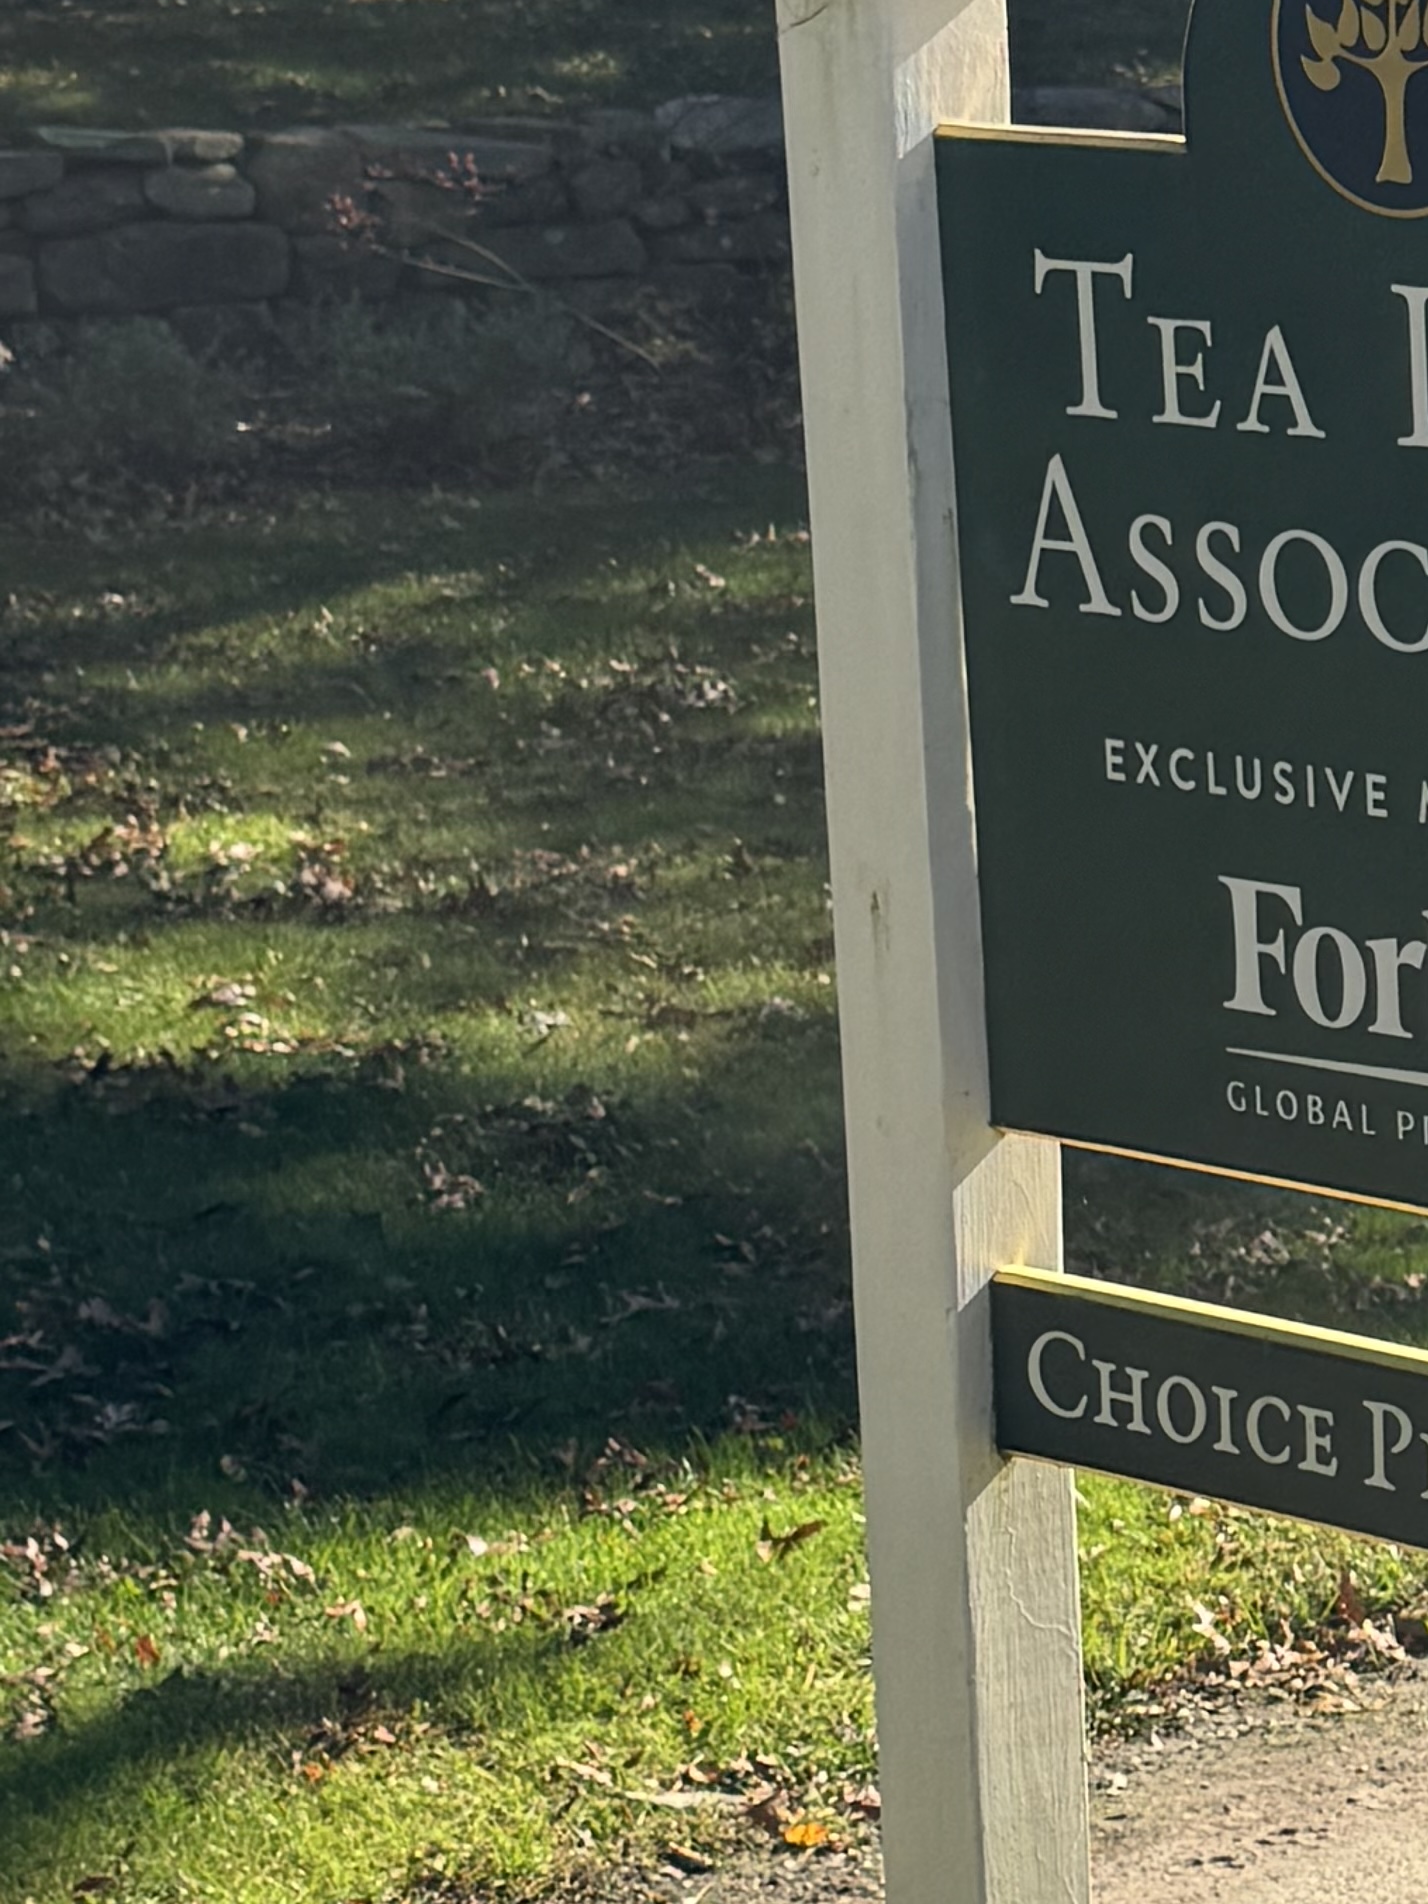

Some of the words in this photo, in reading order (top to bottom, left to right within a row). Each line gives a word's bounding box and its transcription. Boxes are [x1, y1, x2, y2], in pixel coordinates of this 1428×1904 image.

[1034, 247, 1327, 439] TEA
[1104, 736, 1389, 819] EXCLUSIVE
[1225, 1079, 1376, 1136] GLOBAL
[1026, 1329, 1339, 1478] CHOICE
